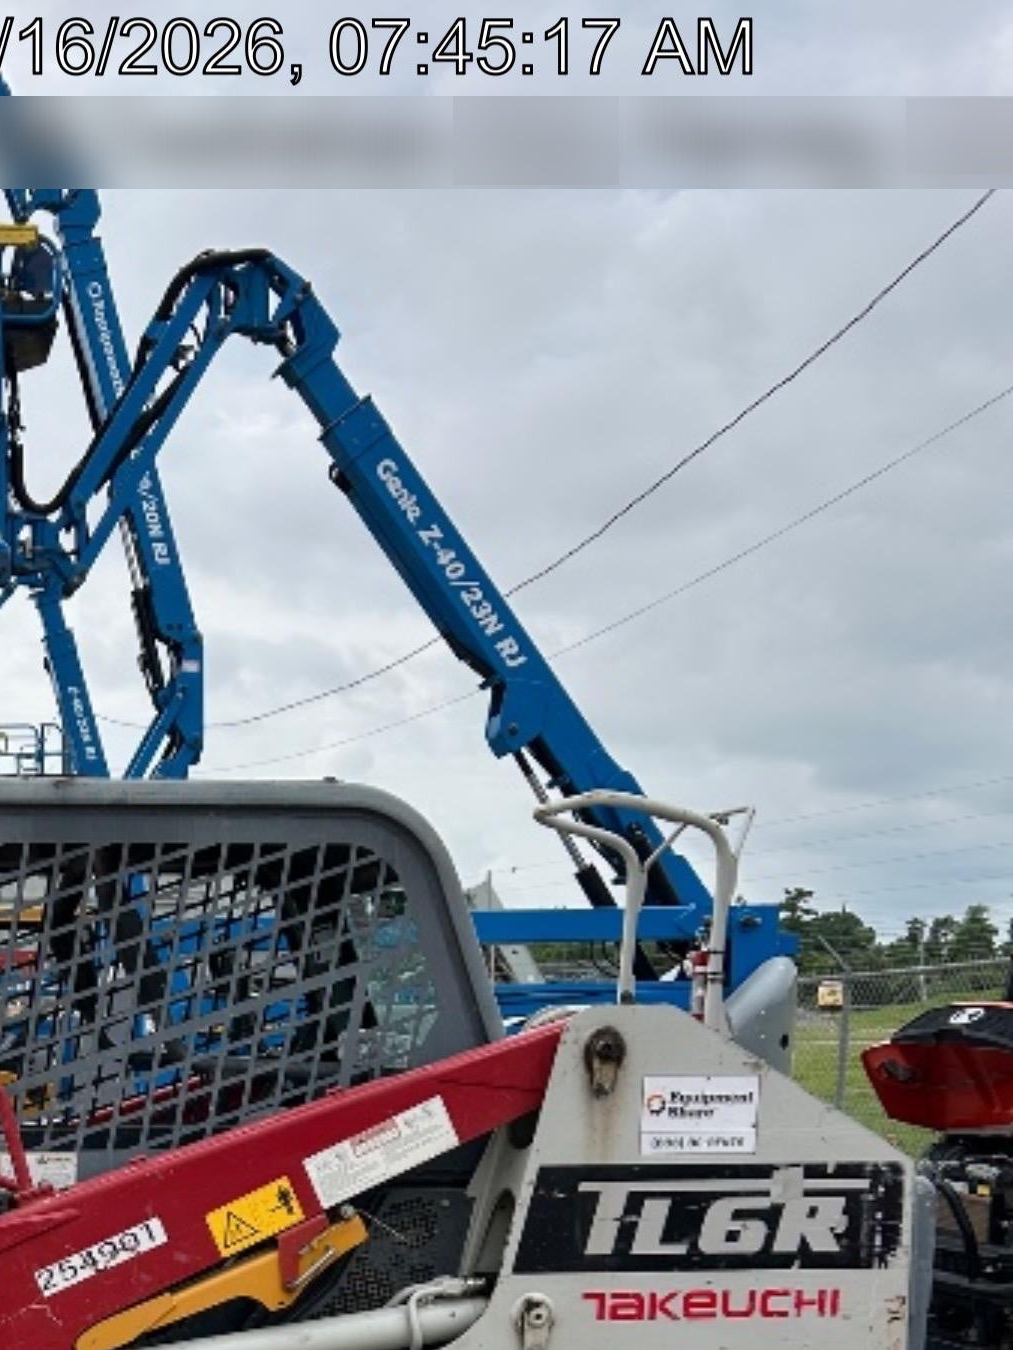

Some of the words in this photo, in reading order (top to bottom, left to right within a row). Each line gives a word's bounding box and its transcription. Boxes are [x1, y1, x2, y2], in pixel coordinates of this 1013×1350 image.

[417, 524, 504, 636] Z-40/23N
[494, 636, 528, 667] RJ
[578, 1168, 870, 1256] TL6R
